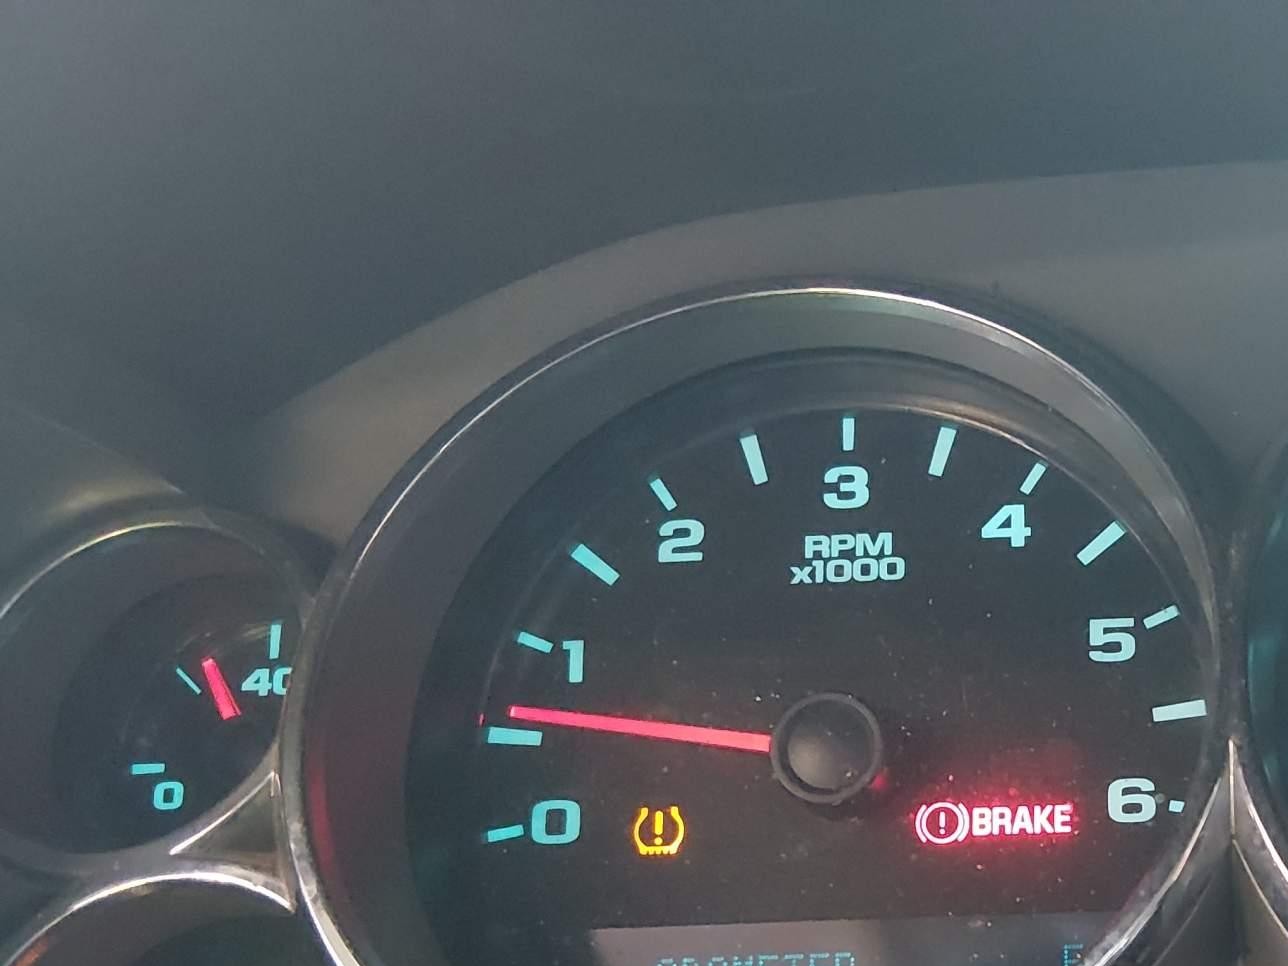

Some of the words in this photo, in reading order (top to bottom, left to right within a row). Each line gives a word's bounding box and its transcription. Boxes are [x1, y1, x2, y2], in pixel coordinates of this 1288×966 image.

[824, 466, 869, 508] 3
[658, 519, 704, 562] 2
[804, 532, 893, 558] RPM
[982, 505, 1031, 547] 4
[790, 556, 905, 585] x1000
[563, 640, 584, 682] 1
[1089, 618, 1135, 662] 5
[154, 782, 183, 810] 0
[1108, 778, 1156, 822] 6
[532, 800, 580, 844] 0
[971, 804, 1072, 836] BRAKE
